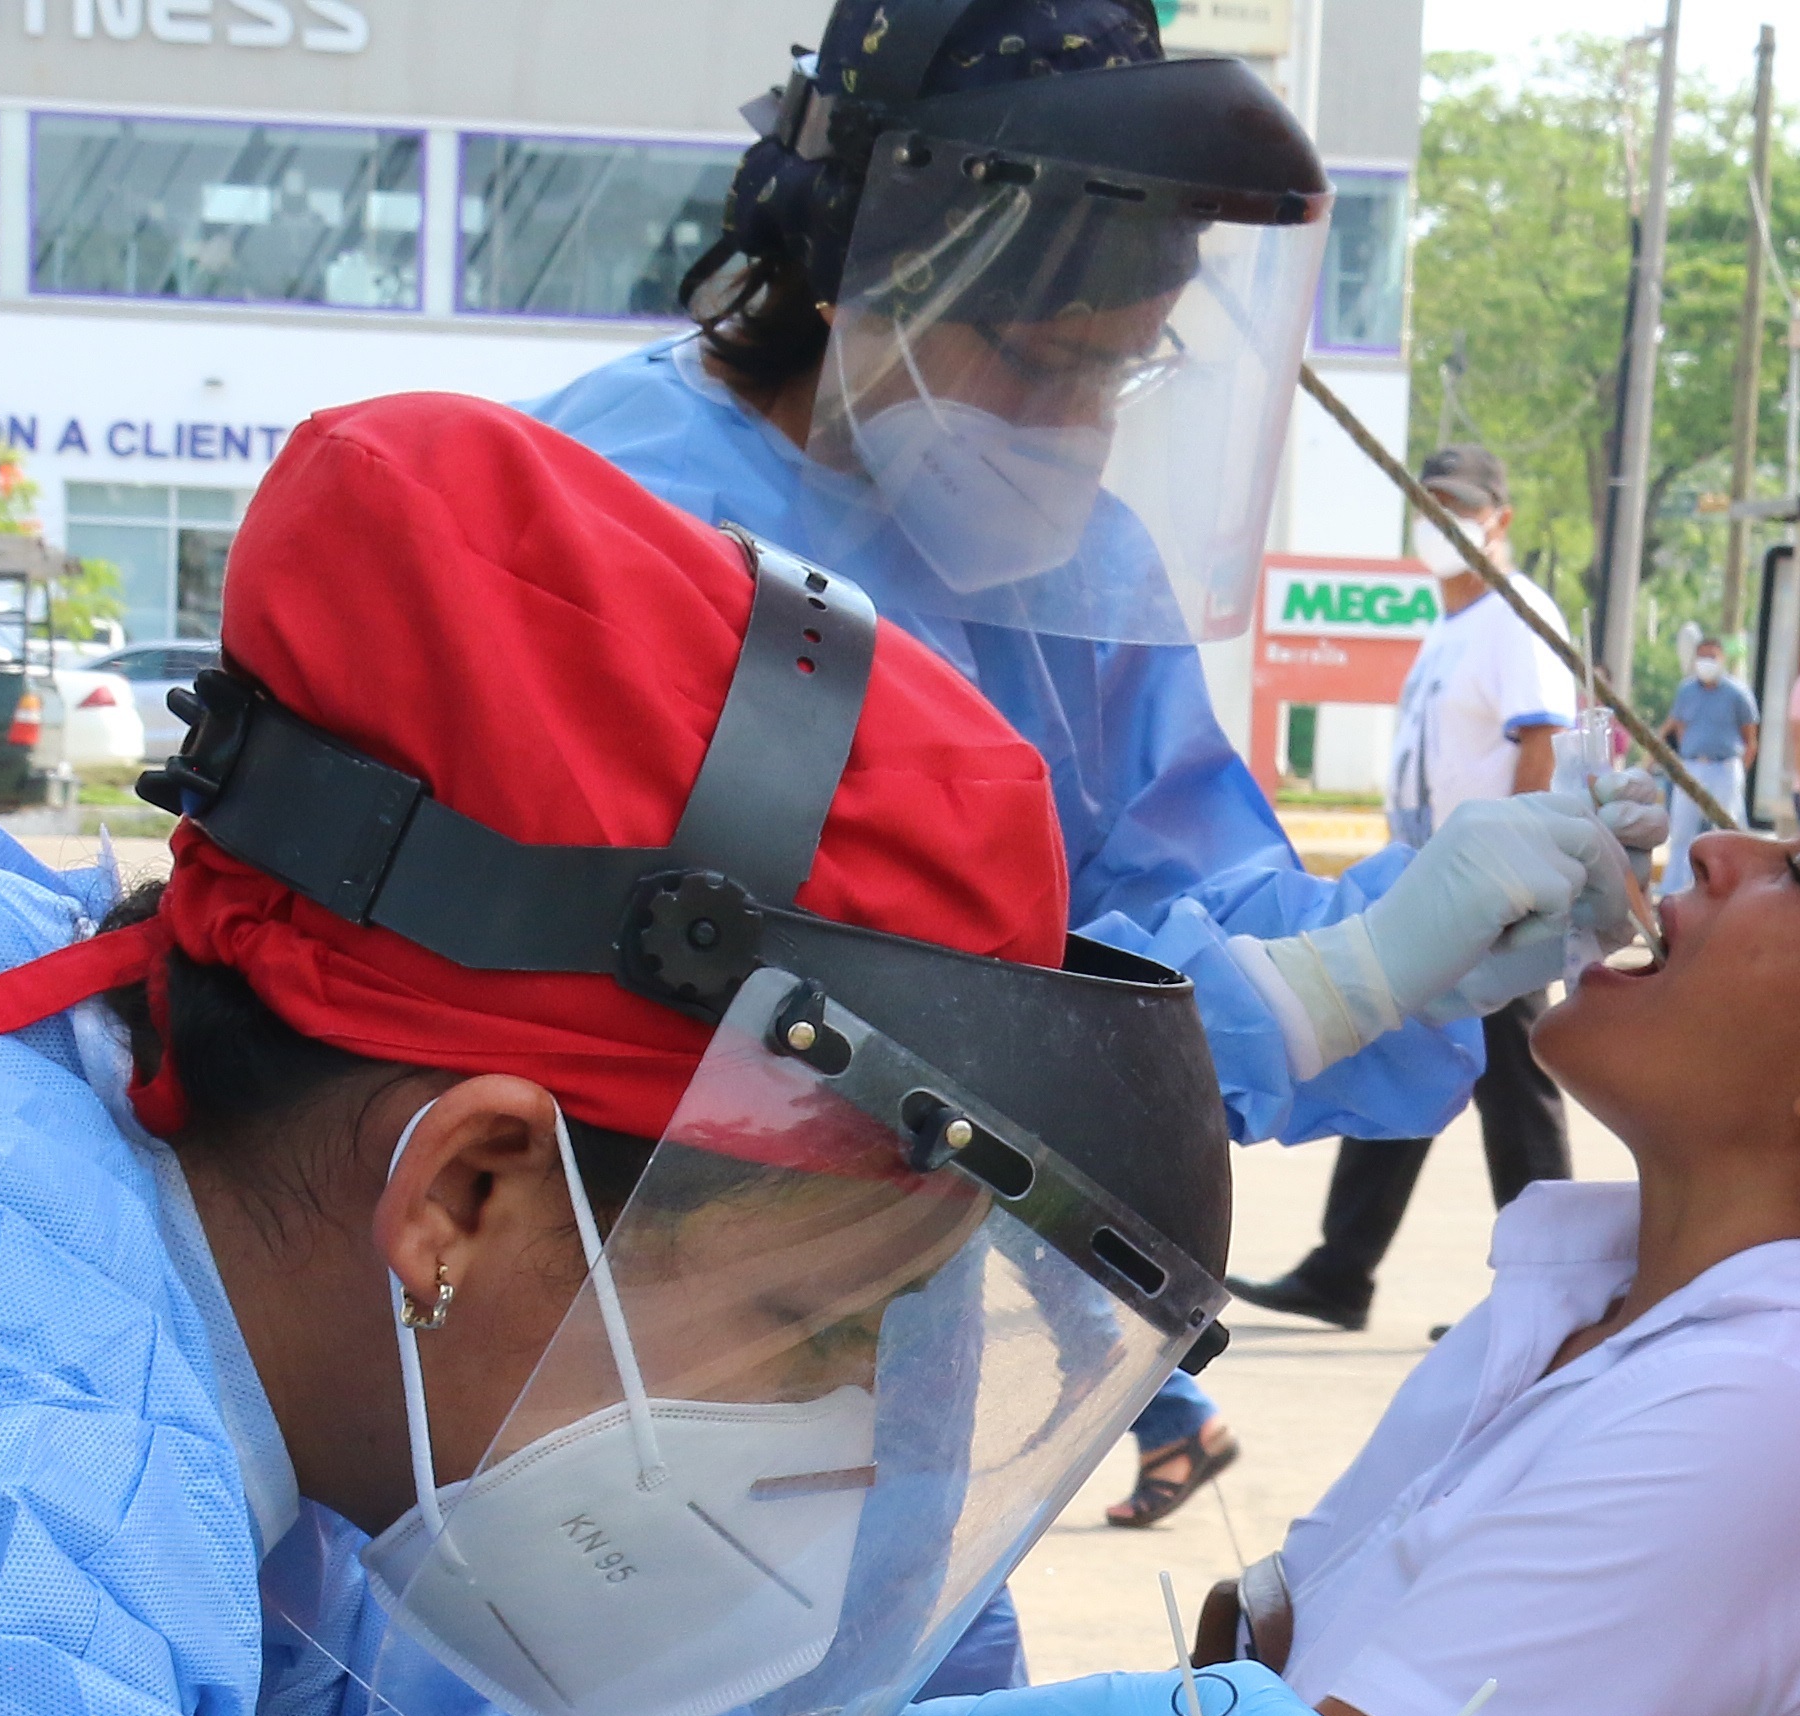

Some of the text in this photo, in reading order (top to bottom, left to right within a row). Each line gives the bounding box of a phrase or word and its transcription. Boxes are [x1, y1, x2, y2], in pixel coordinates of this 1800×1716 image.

[57, 418, 90, 455] A
[1282, 582, 1438, 625] MEGA
[560, 1513, 637, 1583] KN95
